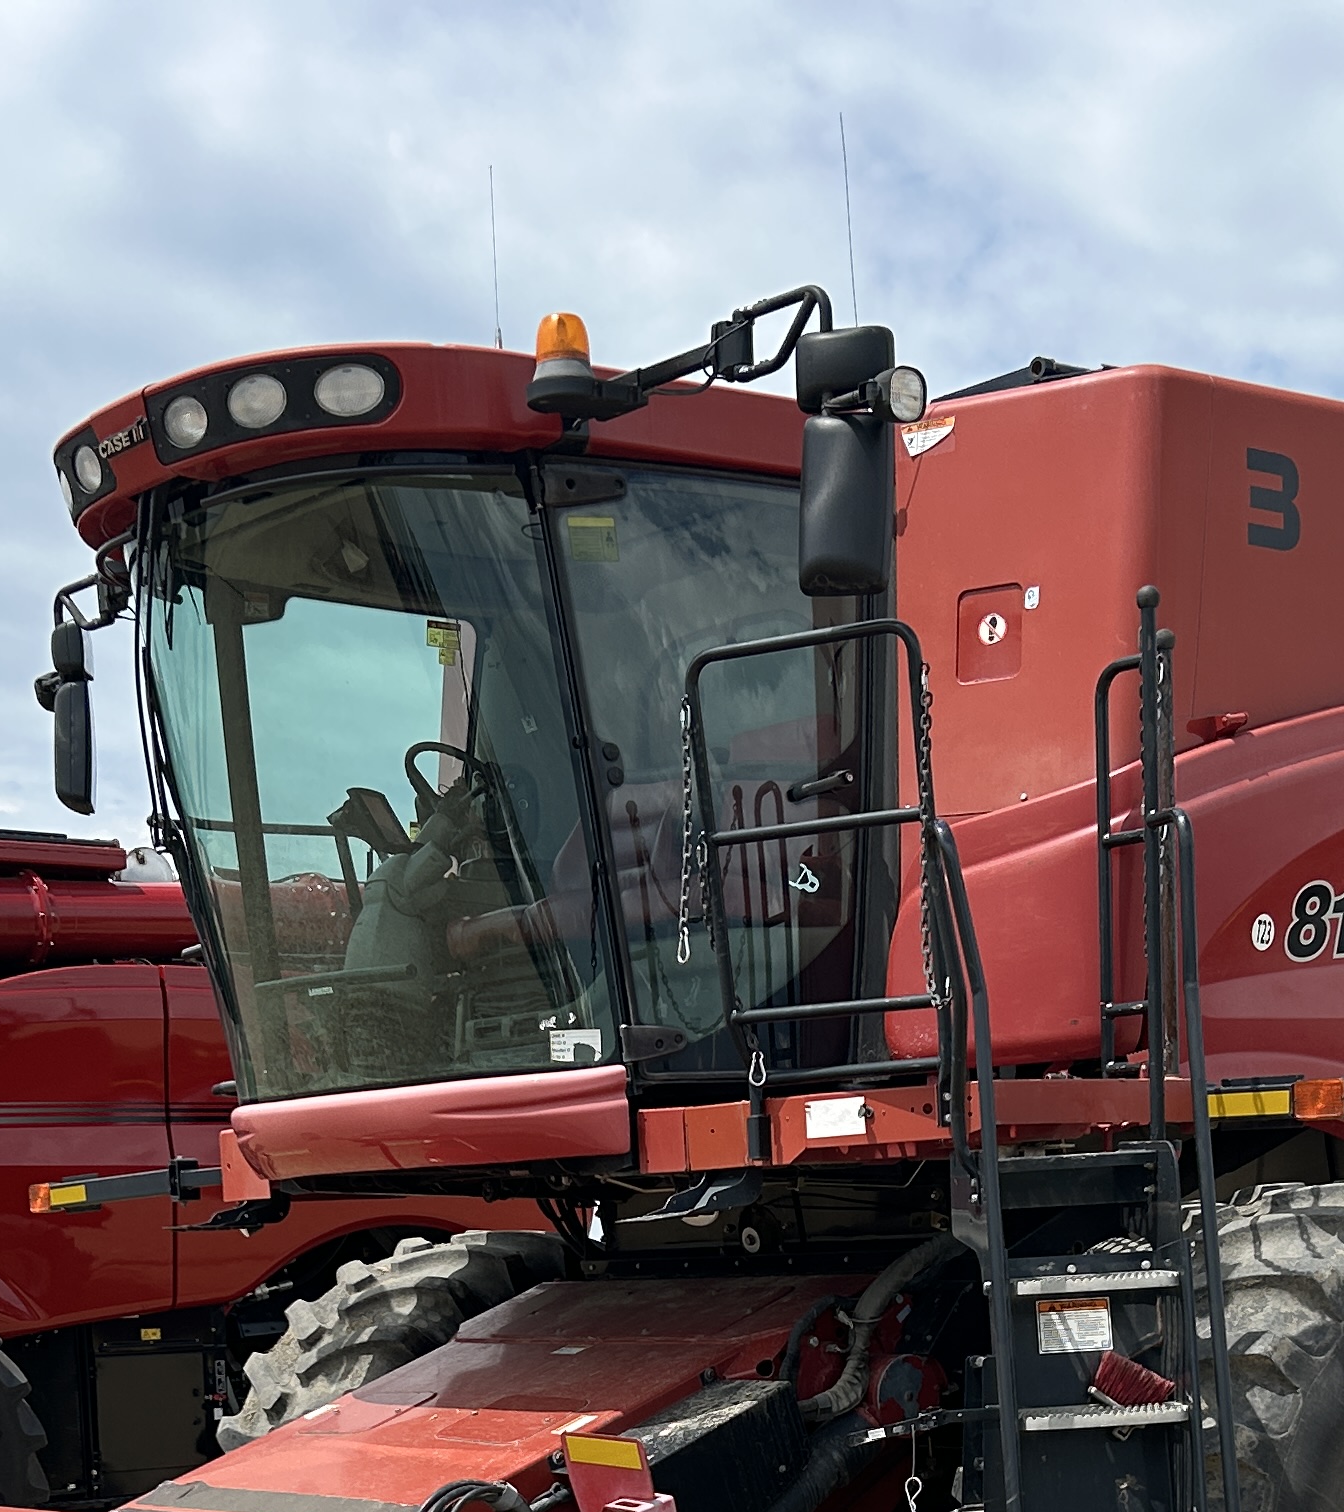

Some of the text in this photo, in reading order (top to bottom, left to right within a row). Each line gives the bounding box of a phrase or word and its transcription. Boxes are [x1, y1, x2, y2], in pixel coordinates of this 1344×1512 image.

[98, 431, 131, 458] CASE
[1246, 447, 1301, 552] 3
[1256, 919, 1272, 945] T23
